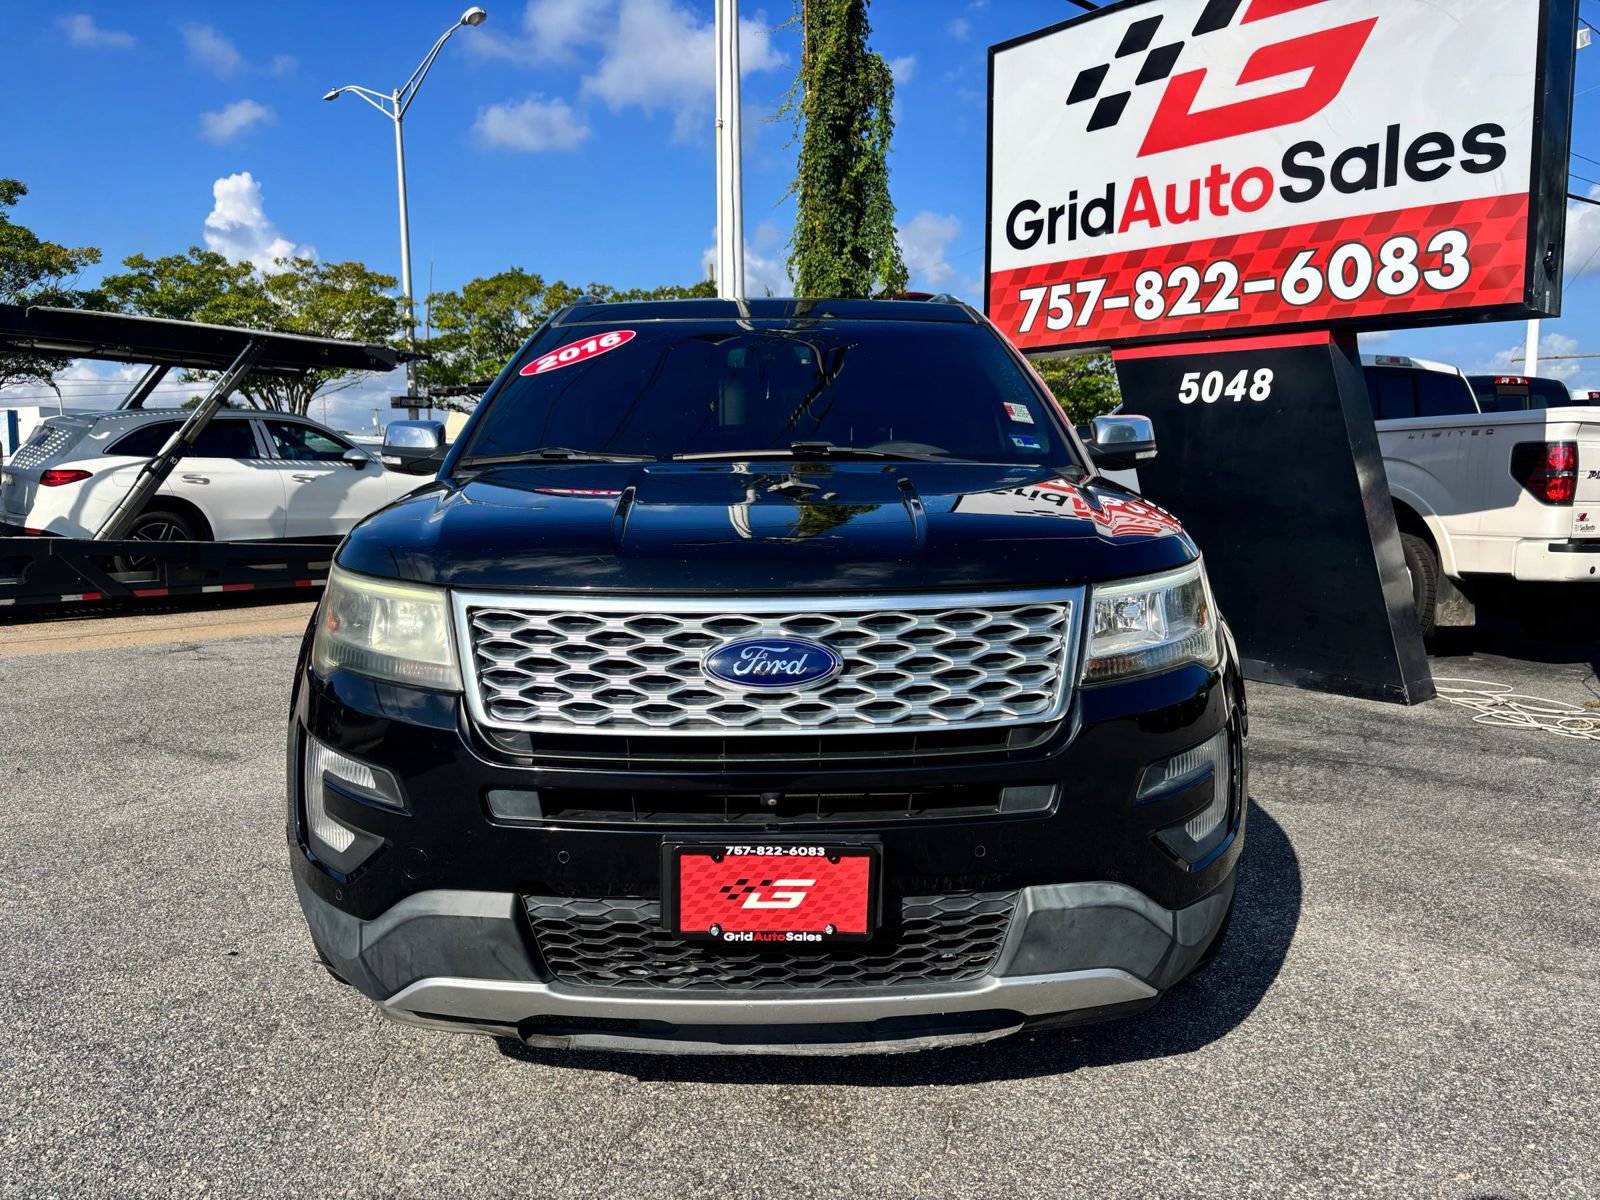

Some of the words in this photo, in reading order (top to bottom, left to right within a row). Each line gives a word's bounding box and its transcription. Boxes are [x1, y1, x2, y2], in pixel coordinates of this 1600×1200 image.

[1005, 122, 1506, 250] GridAutoSales
[1017, 229, 1471, 334] 757-822-6083
[535, 332, 622, 374] 2016
[1178, 368, 1274, 404] 5048
[1407, 428, 1495, 440] LIMITED
[733, 646, 808, 676] Ford
[725, 846, 825, 857] 757-822-6083
[723, 931, 822, 942] GridAutoSales
